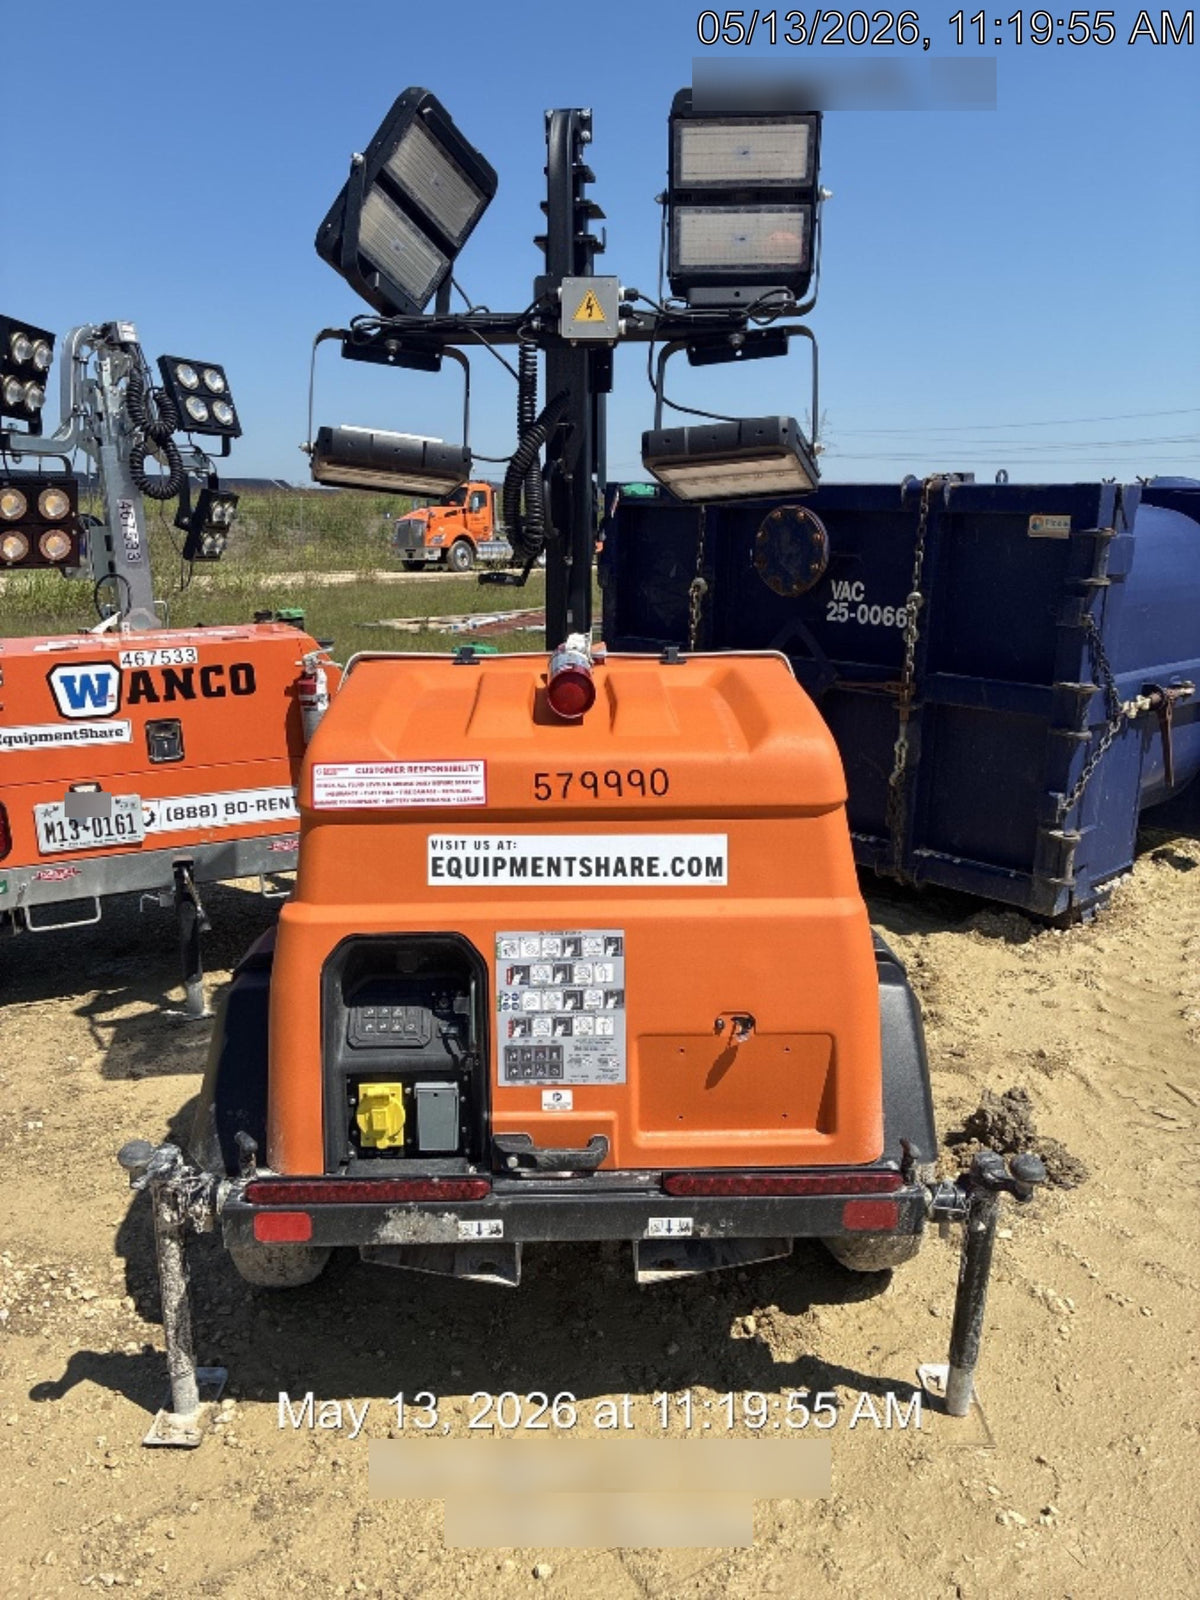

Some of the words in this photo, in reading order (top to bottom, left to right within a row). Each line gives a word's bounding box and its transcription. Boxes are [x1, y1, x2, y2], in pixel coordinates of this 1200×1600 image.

[831, 580, 865, 601] VAC
[826, 601, 908, 628] 25-0066
[122, 648, 196, 667] 467533
[0, 728, 125, 747] quipmentShare
[355, 766, 406, 775] CUSTOMER
[407, 764, 480, 774] RESPONSIBILITY
[534, 768, 669, 801] 579990
[166, 803, 218, 822] (888)
[431, 840, 467, 850] VISIT
[474, 840, 490, 850] US
[497, 840, 517, 850] AT:
[431, 856, 723, 880] EQUIPMENTSHARE.COM
